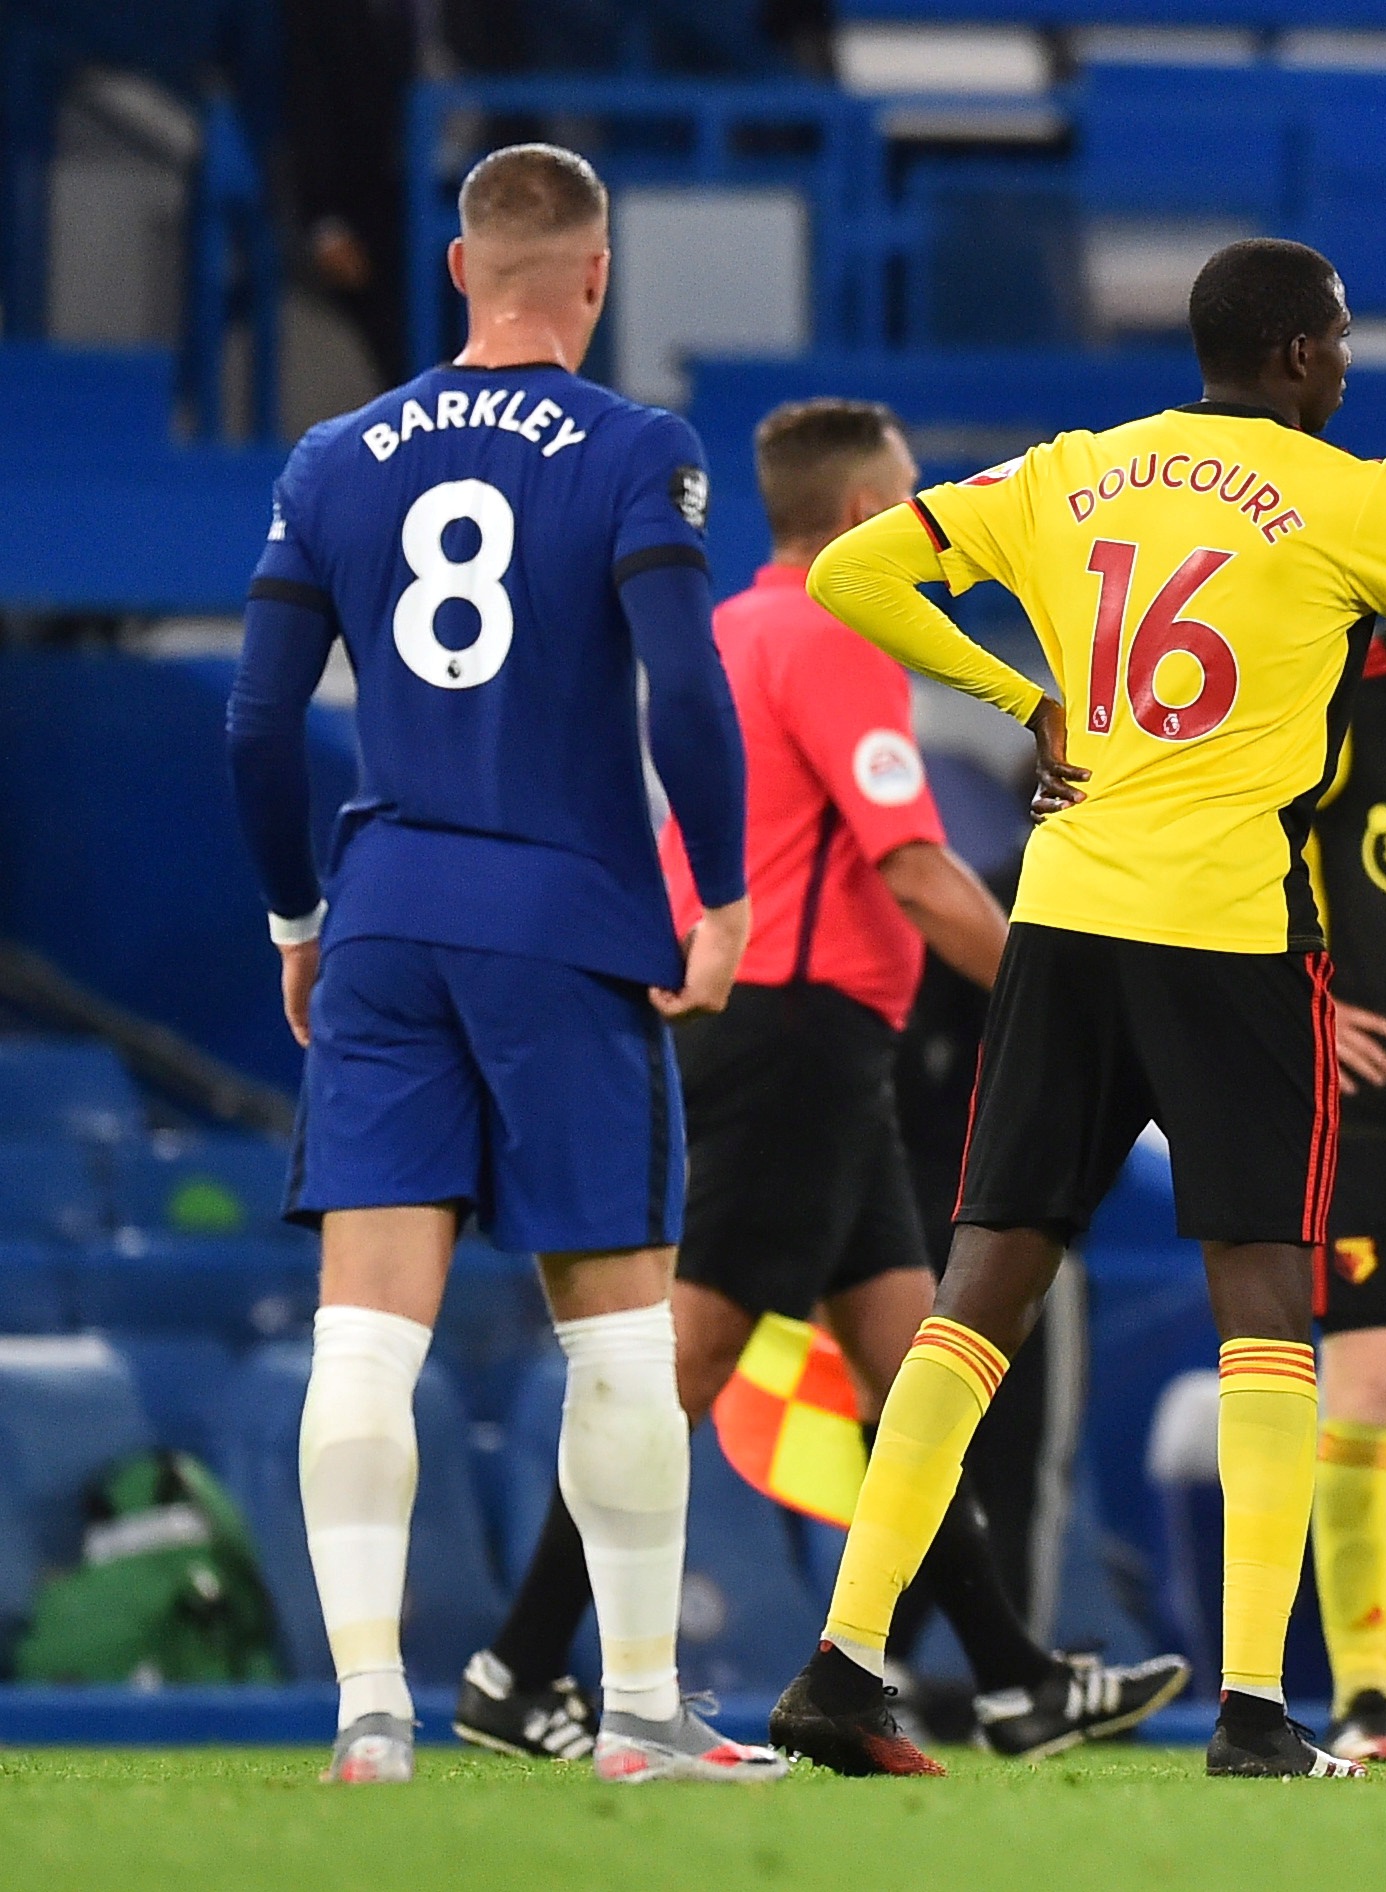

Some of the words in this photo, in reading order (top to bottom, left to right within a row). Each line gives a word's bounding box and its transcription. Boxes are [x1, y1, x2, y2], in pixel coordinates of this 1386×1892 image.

[361, 388, 587, 463] BARKLEY
[1068, 453, 1305, 545] DOUCOURE
[392, 477, 515, 690] 8
[1087, 538, 1239, 742] 16
